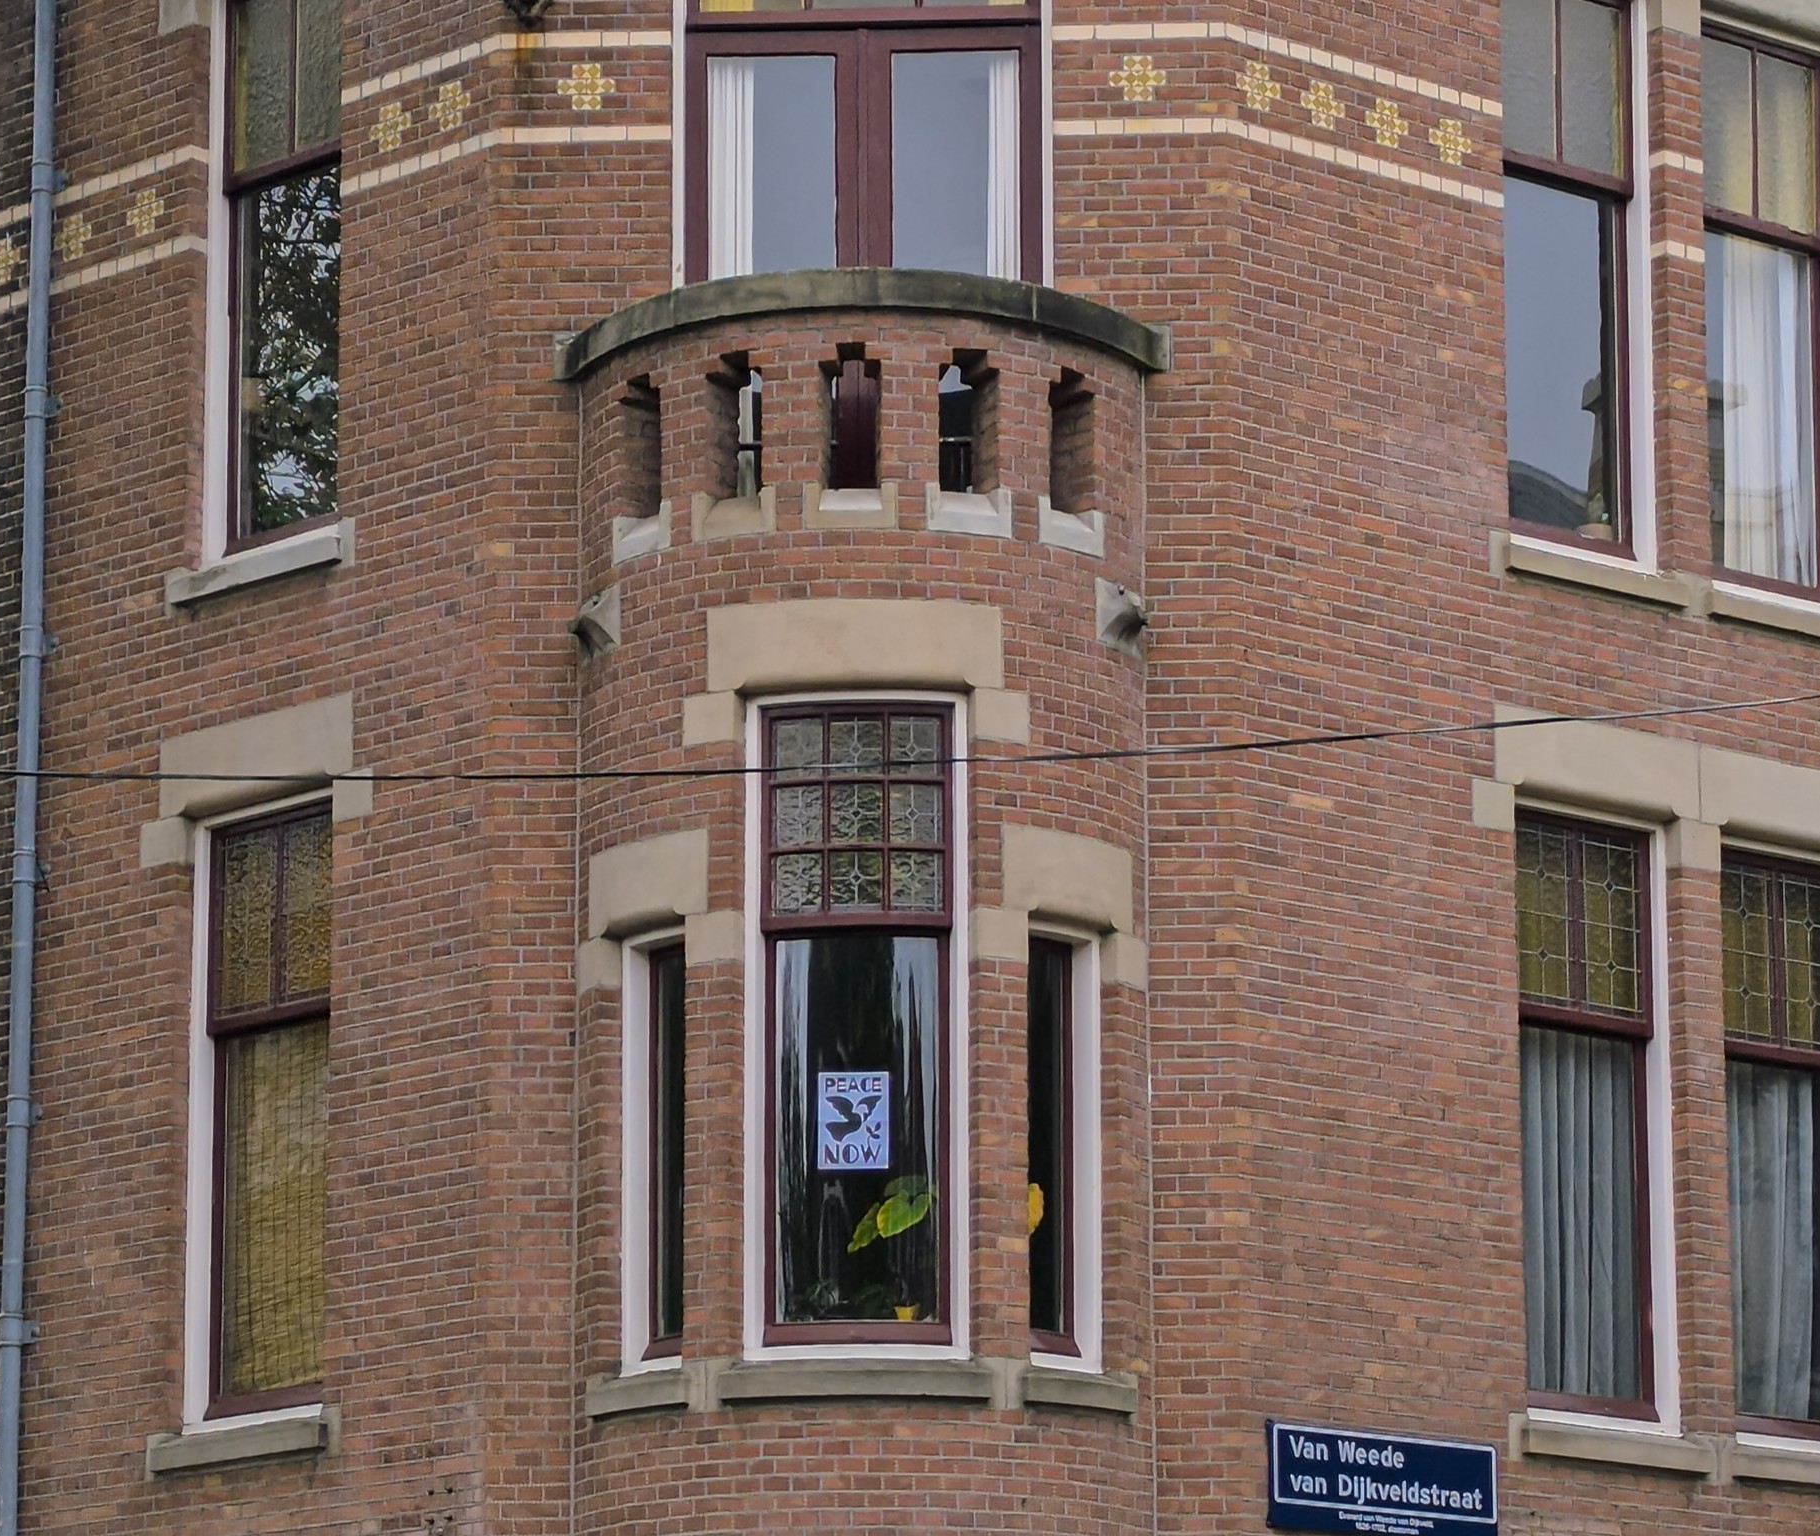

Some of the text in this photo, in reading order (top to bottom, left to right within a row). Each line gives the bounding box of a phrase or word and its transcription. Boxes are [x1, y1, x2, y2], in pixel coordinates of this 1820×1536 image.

[825, 1077, 882, 1093] PEACE
[824, 1144, 882, 1164] NOW
[1288, 1434, 1405, 1469] Van Weede
[1290, 1473, 1483, 1511] van Dijkveldstraat
